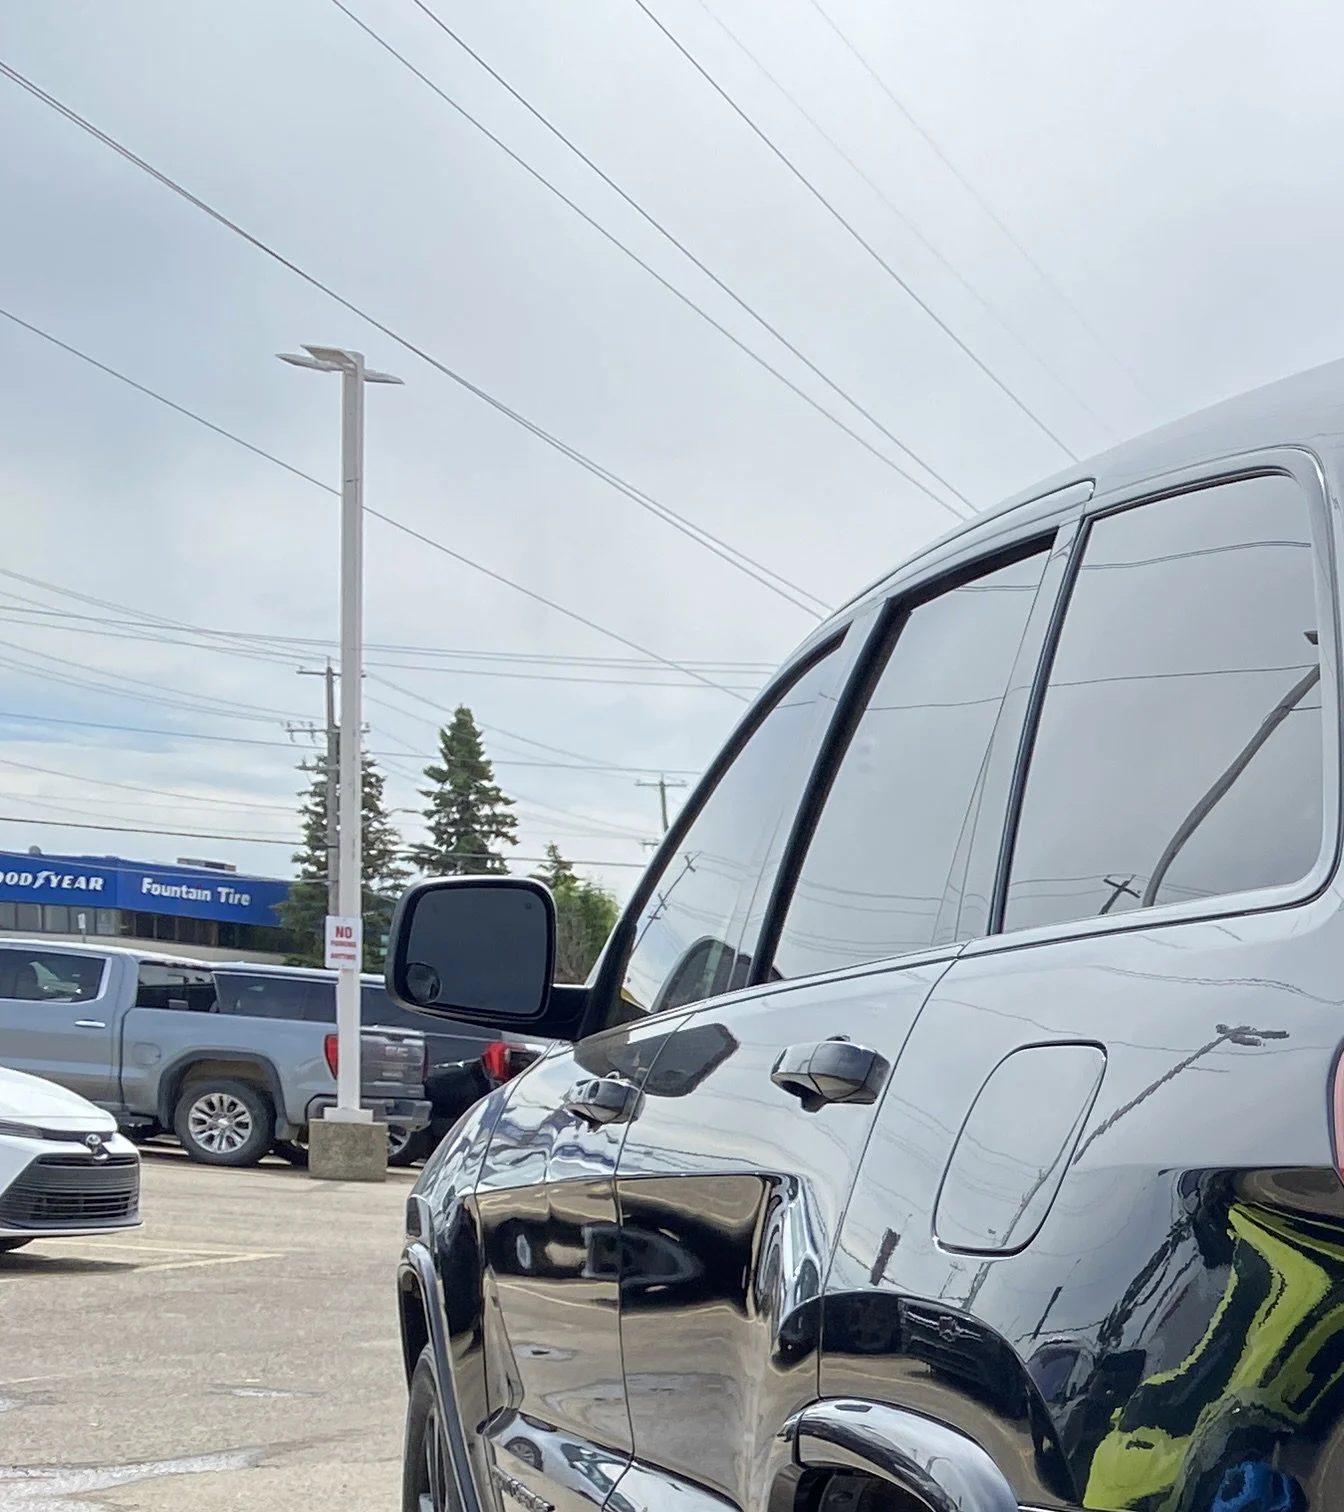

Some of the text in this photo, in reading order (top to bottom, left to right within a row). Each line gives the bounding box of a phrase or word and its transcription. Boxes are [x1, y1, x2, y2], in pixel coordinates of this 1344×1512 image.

[141, 877, 251, 906] Fountain Tire
[335, 925, 353, 939] NO
